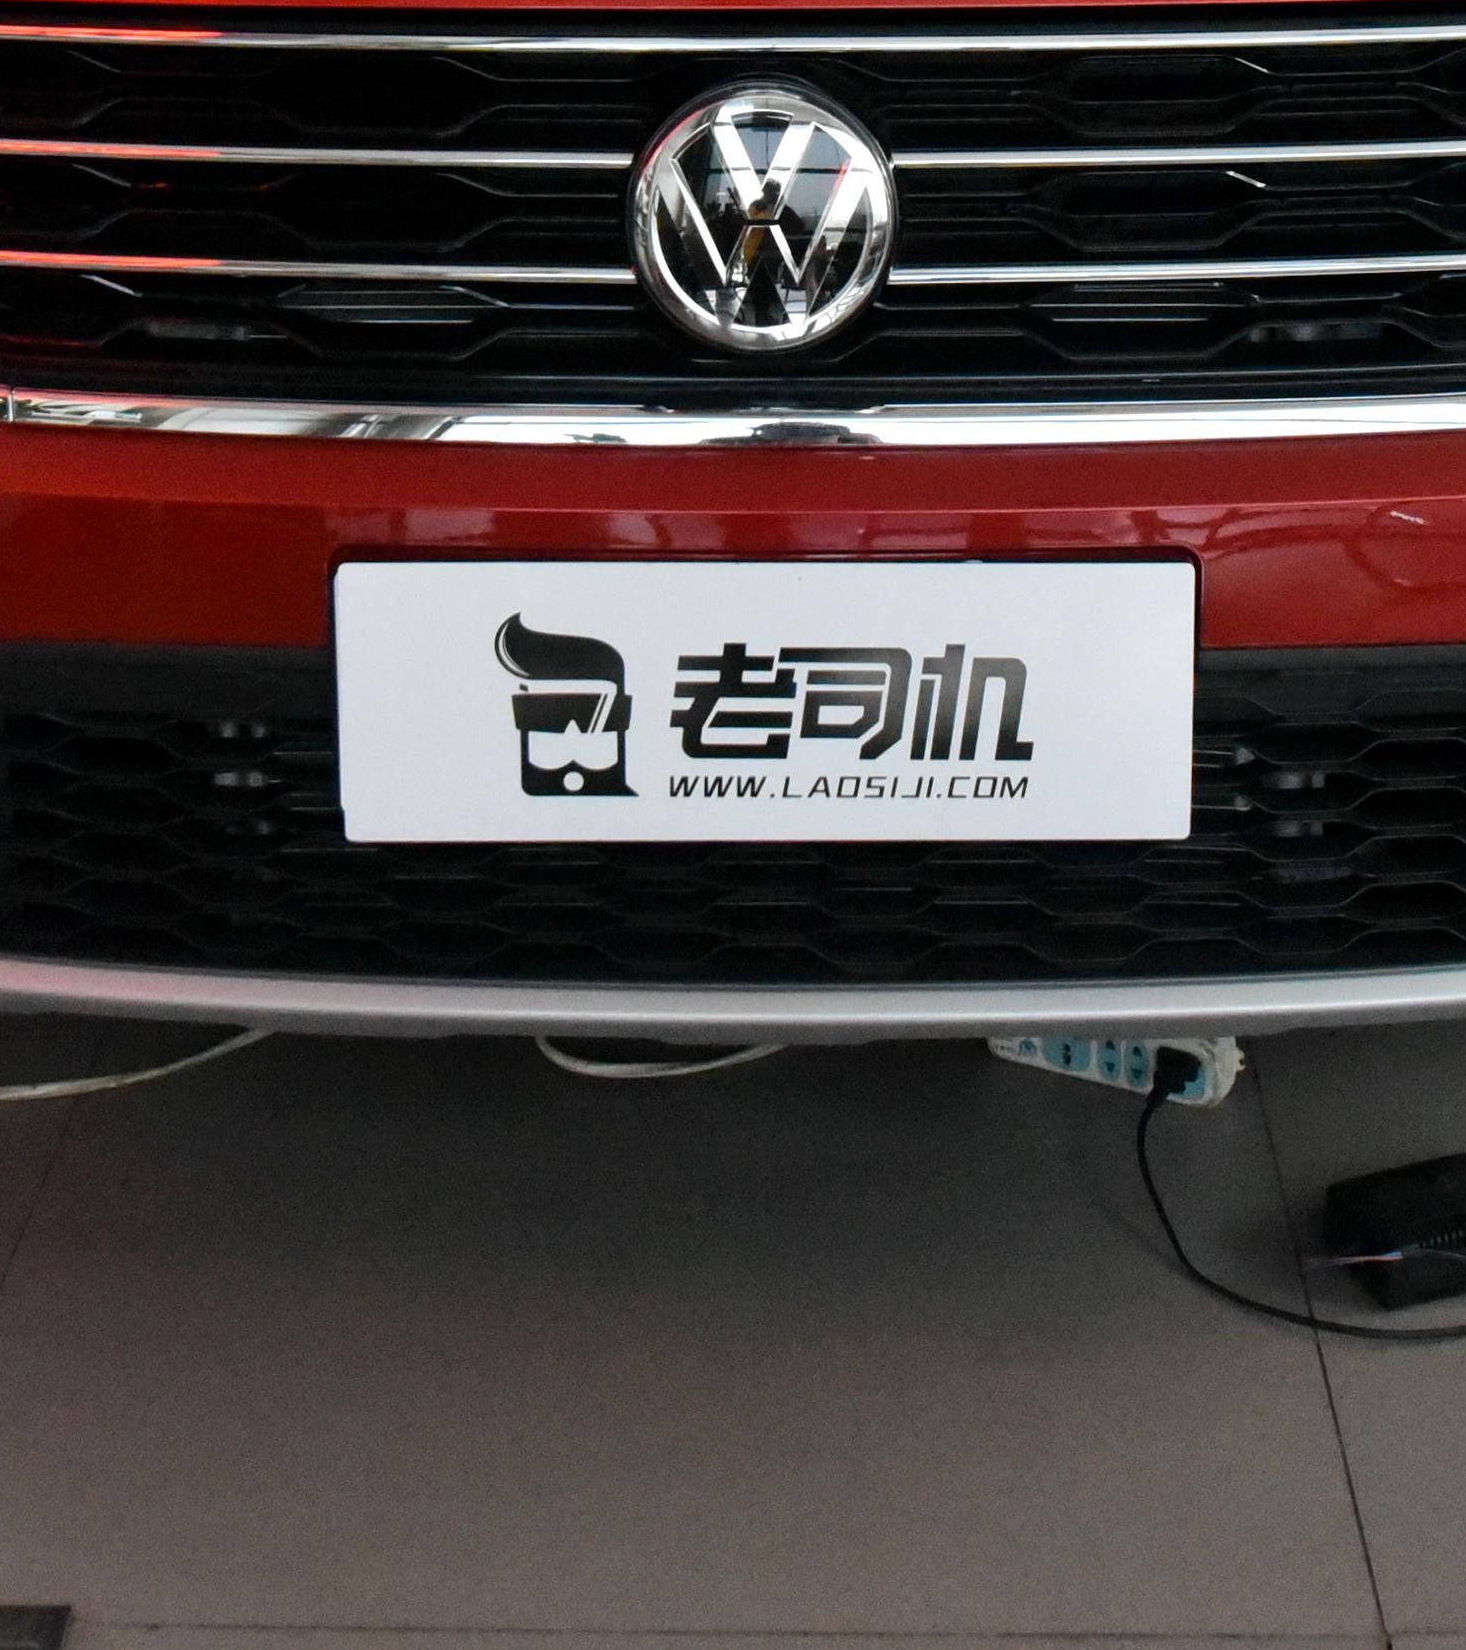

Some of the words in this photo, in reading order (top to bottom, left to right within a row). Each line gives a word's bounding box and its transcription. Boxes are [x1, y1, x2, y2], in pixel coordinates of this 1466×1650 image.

[635, 90, 893, 350] VW
[670, 643, 1034, 761] 老司机
[668, 774, 1029, 800] WWW.LAOSIJI.COM
